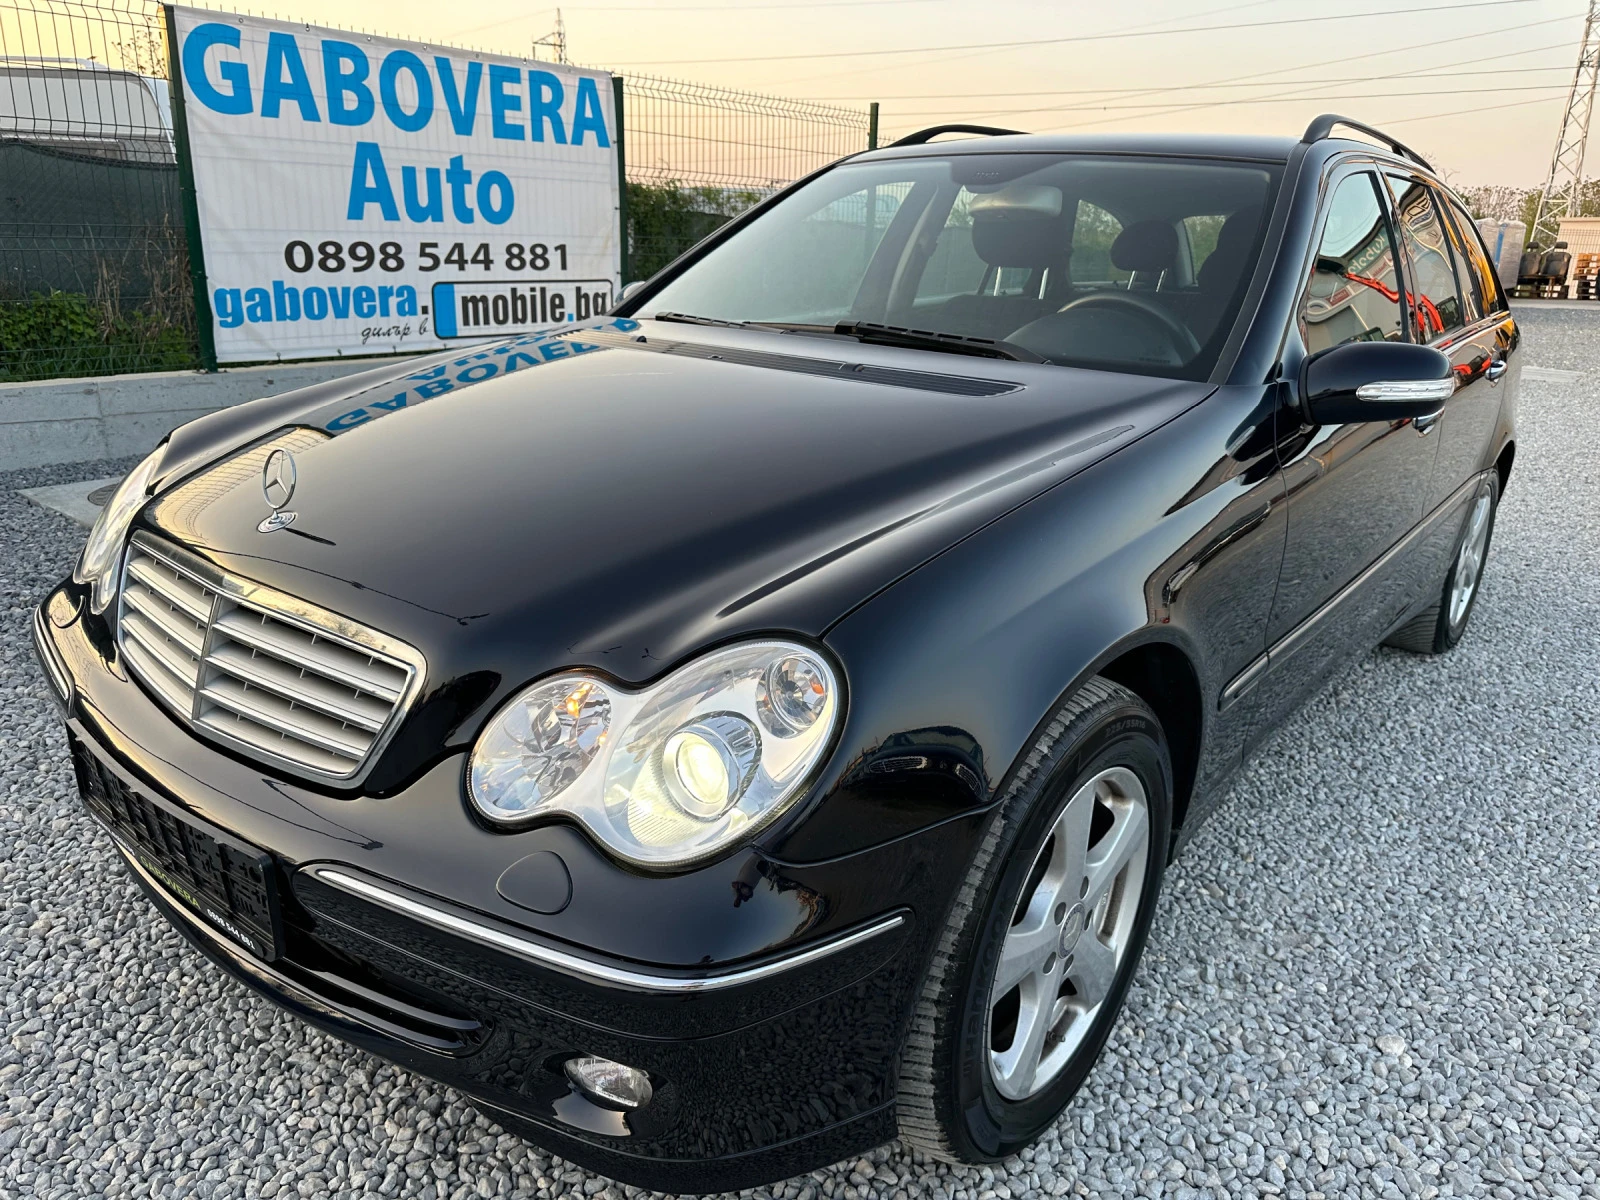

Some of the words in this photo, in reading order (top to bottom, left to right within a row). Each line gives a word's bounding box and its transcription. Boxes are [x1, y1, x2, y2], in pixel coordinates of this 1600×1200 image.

[182, 22, 611, 149] GABOVERA
[346, 141, 515, 225] Auto
[284, 240, 405, 273] 0898
[418, 242, 494, 272] 544
[505, 243, 568, 271] 881
[140, 855, 201, 910] GABOVERA
[225, 921, 241, 938] 544
